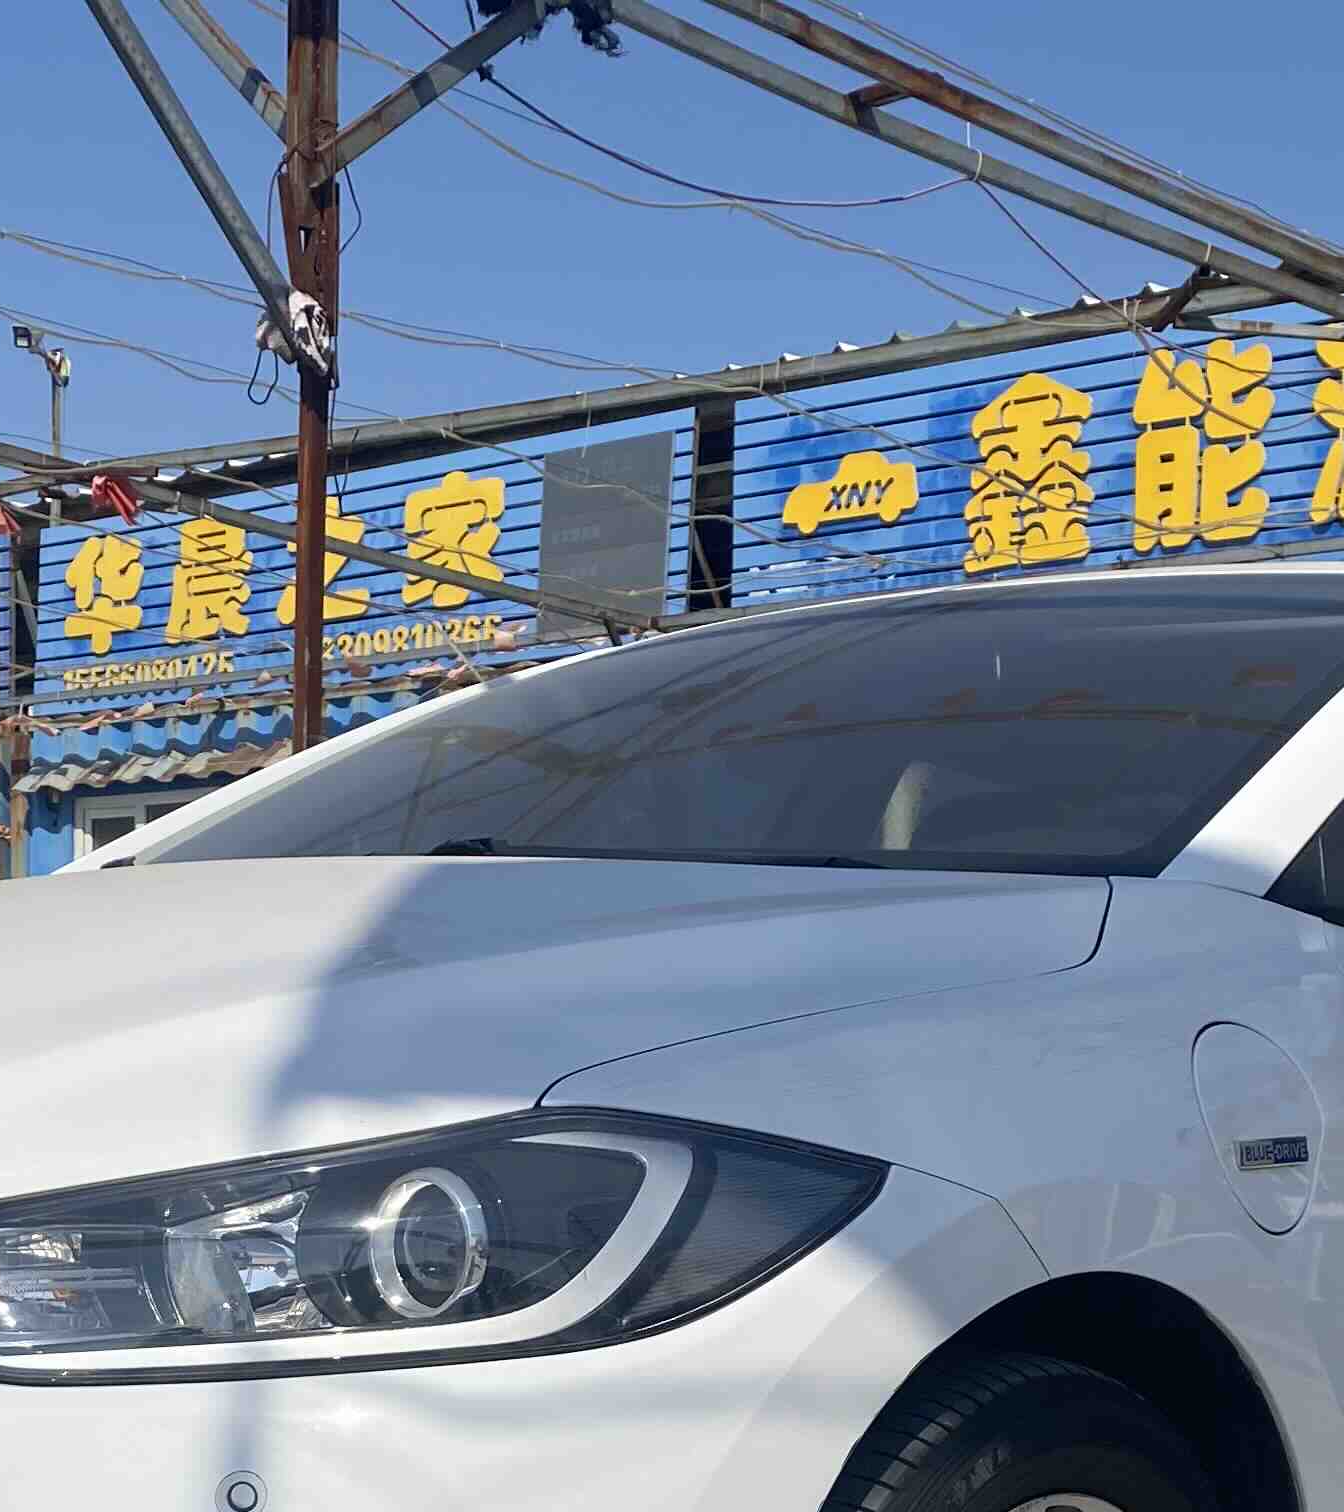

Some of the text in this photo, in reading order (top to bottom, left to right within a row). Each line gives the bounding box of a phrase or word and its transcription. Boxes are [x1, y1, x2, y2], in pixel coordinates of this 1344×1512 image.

[824, 477, 894, 512] XNY
[63, 471, 506, 656] 华晨之家
